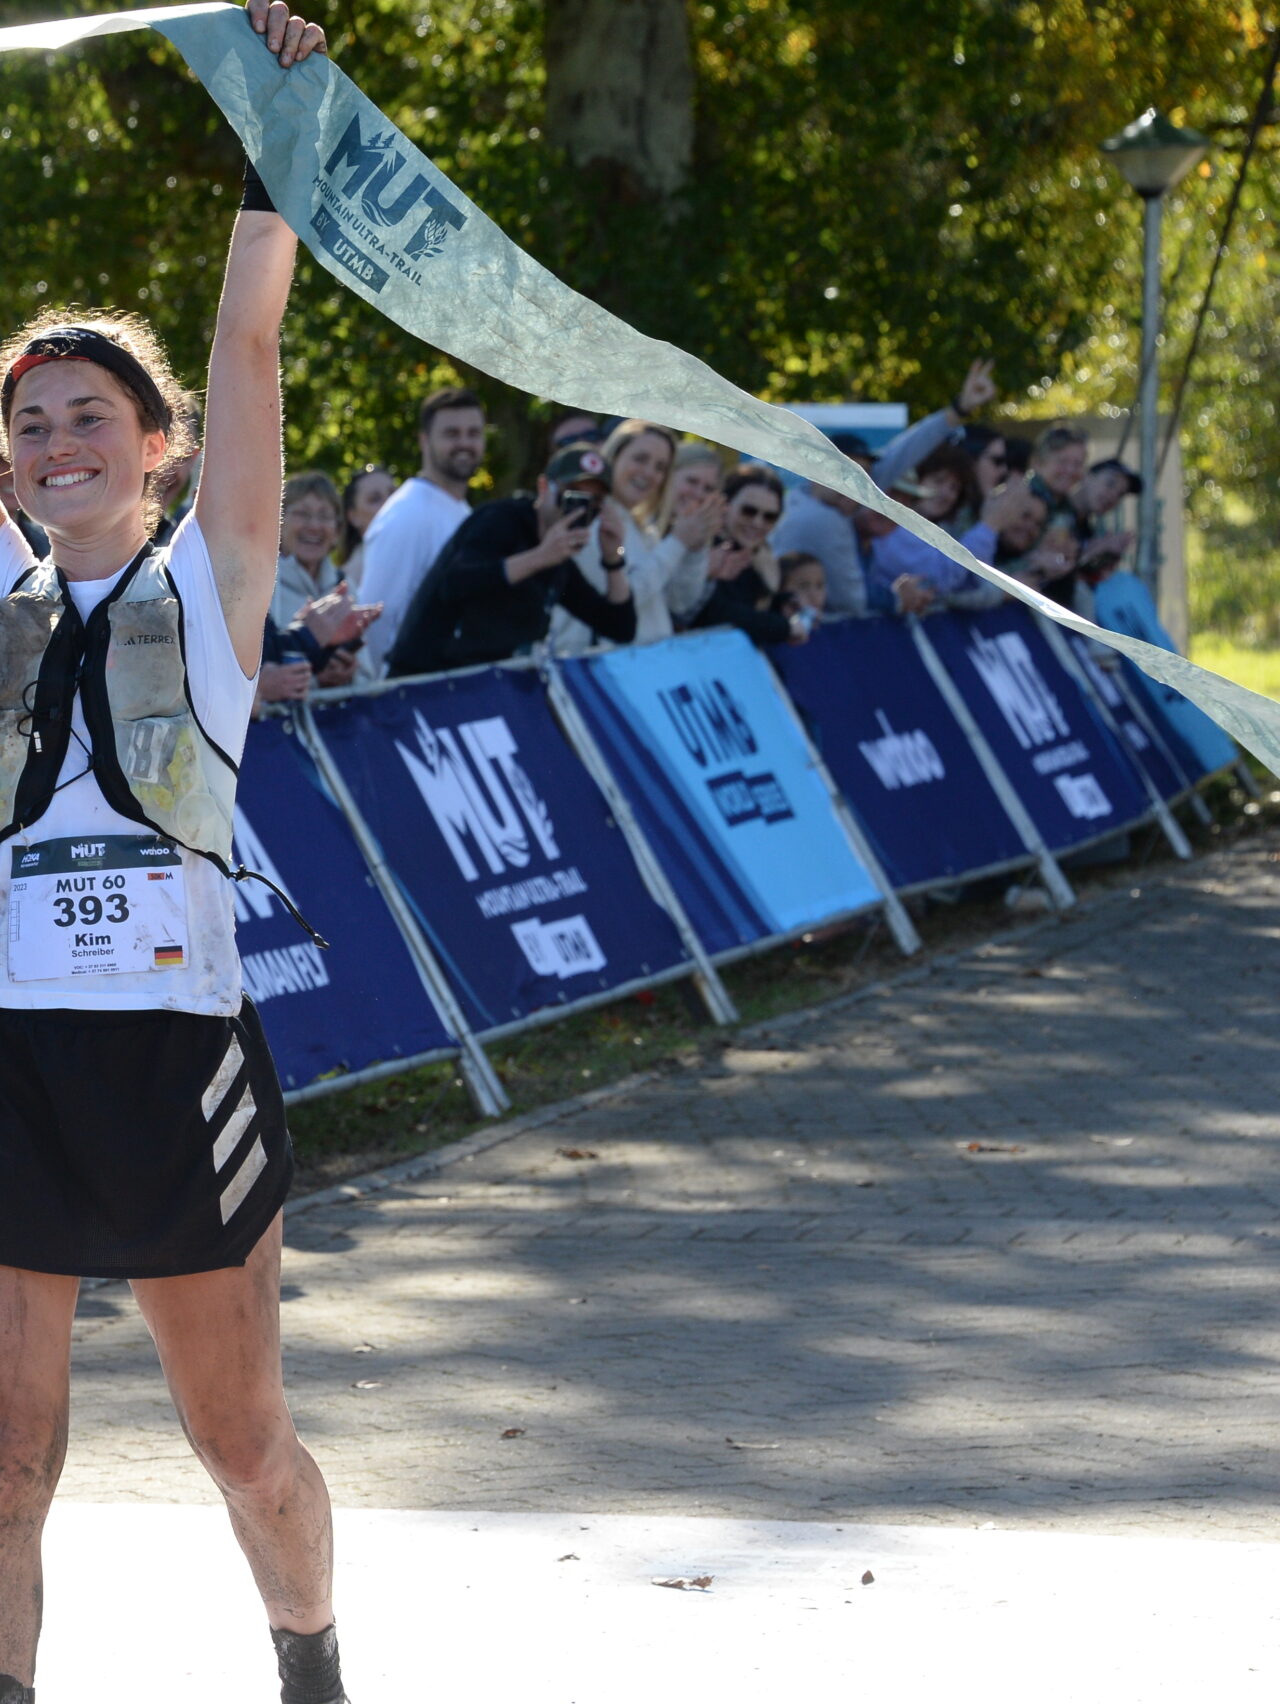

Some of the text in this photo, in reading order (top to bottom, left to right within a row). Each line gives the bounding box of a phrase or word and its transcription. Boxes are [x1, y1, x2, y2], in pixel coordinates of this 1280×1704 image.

[324, 111, 468, 261] MUT
[312, 175, 424, 287] MOUNTAIN ULTRA-TRAIL
[315, 213, 375, 282] BY UTMB
[136, 634, 176, 645] TERREX
[656, 678, 758, 768] UTMB
[394, 708, 560, 881] MUT
[71, 843, 106, 858] MUT
[56, 875, 126, 893] MUT 60
[53, 893, 130, 928] 393
[71, 948, 115, 958] Schreiber
[75, 933, 111, 947] Kim
